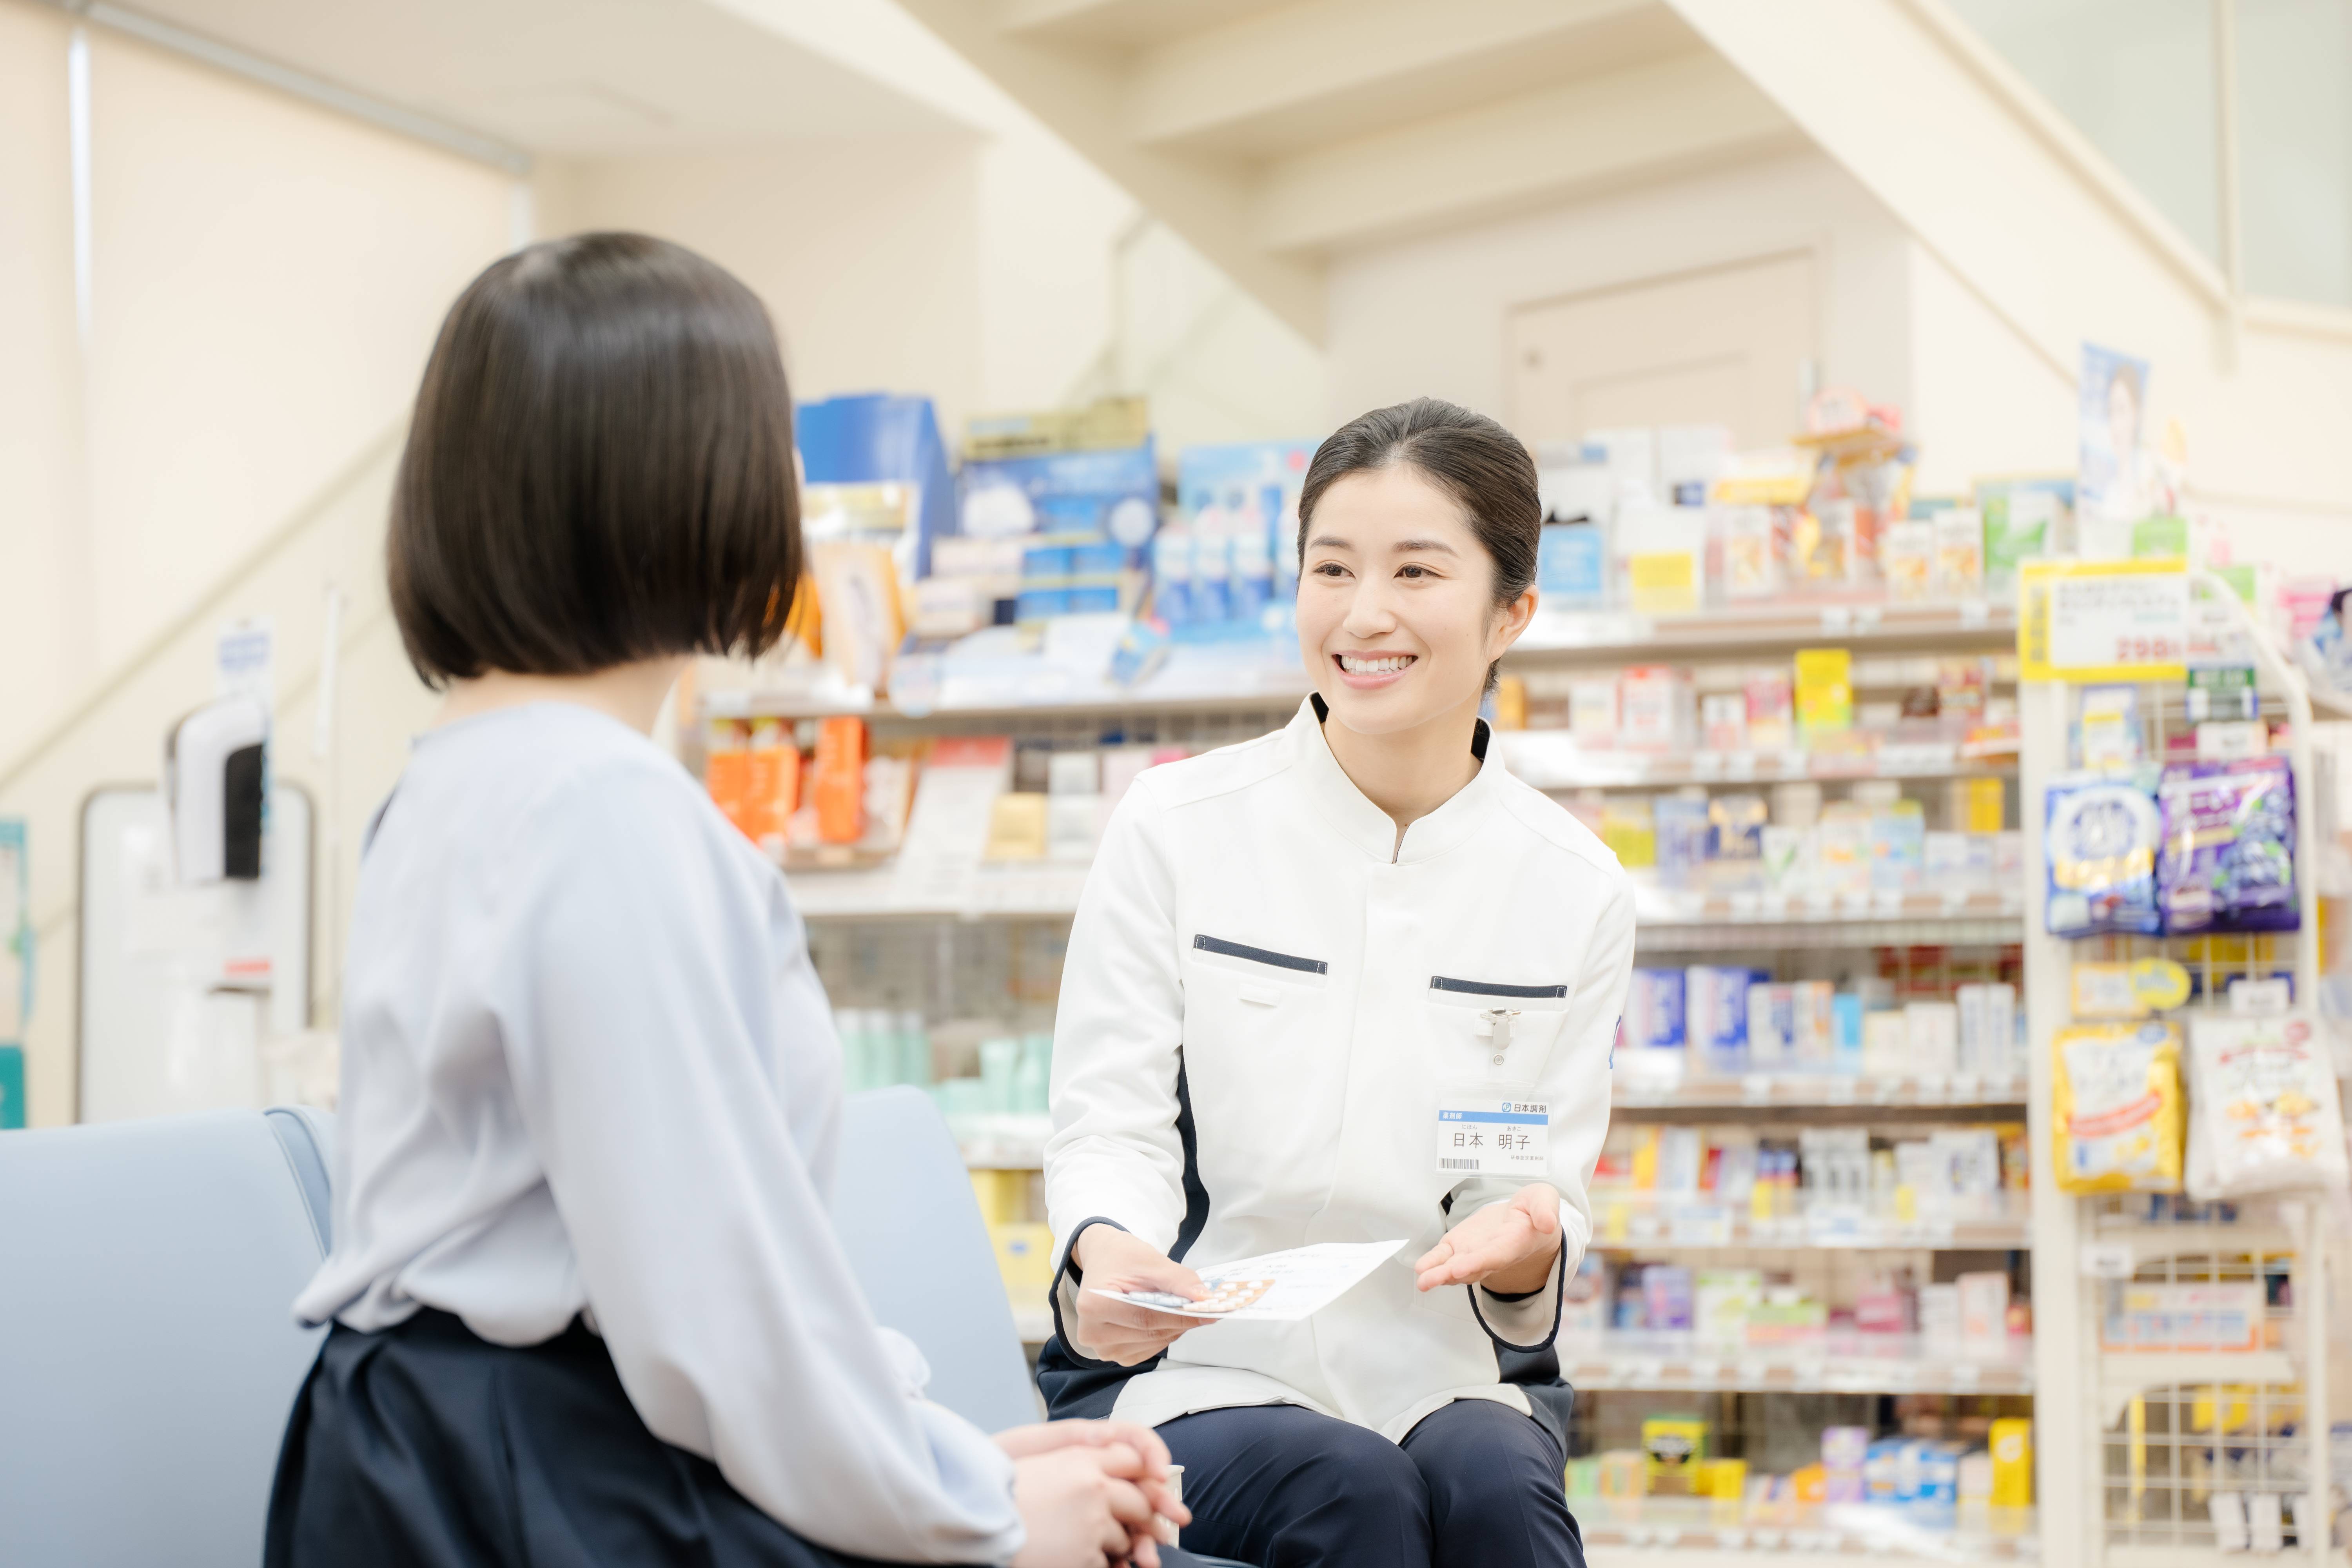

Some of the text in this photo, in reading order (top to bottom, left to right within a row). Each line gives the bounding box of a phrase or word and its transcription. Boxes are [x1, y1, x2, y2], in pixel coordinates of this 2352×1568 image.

[1514, 1104, 1546, 1113] 日本調剤
[1454, 1132, 1530, 1149] 日本 明子
